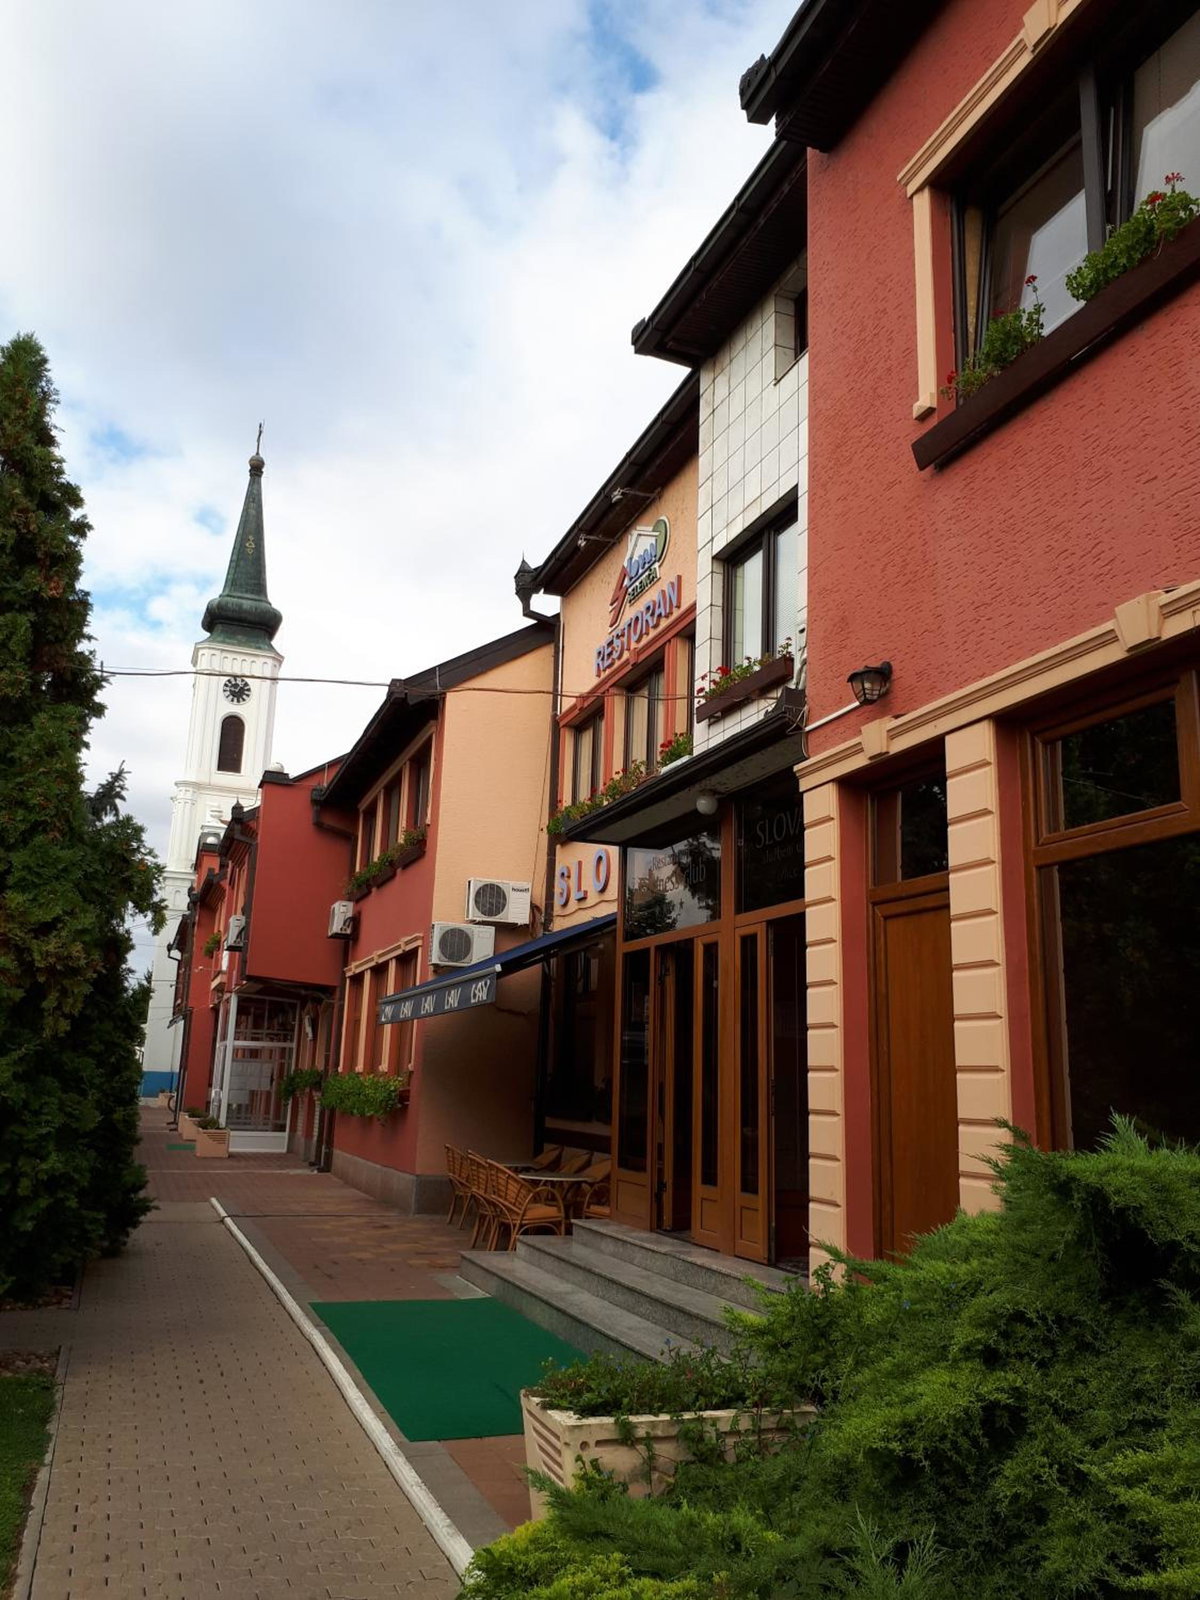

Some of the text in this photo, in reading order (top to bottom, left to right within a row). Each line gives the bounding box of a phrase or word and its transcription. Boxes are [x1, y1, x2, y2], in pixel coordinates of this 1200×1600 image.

[594, 575, 682, 677] RESTORAN
[557, 848, 610, 907] SLO
[400, 1000, 414, 1018] LAV
[421, 994, 436, 1014] LAV
[444, 987, 461, 1010] LAV
[471, 979, 490, 1003] LAV
